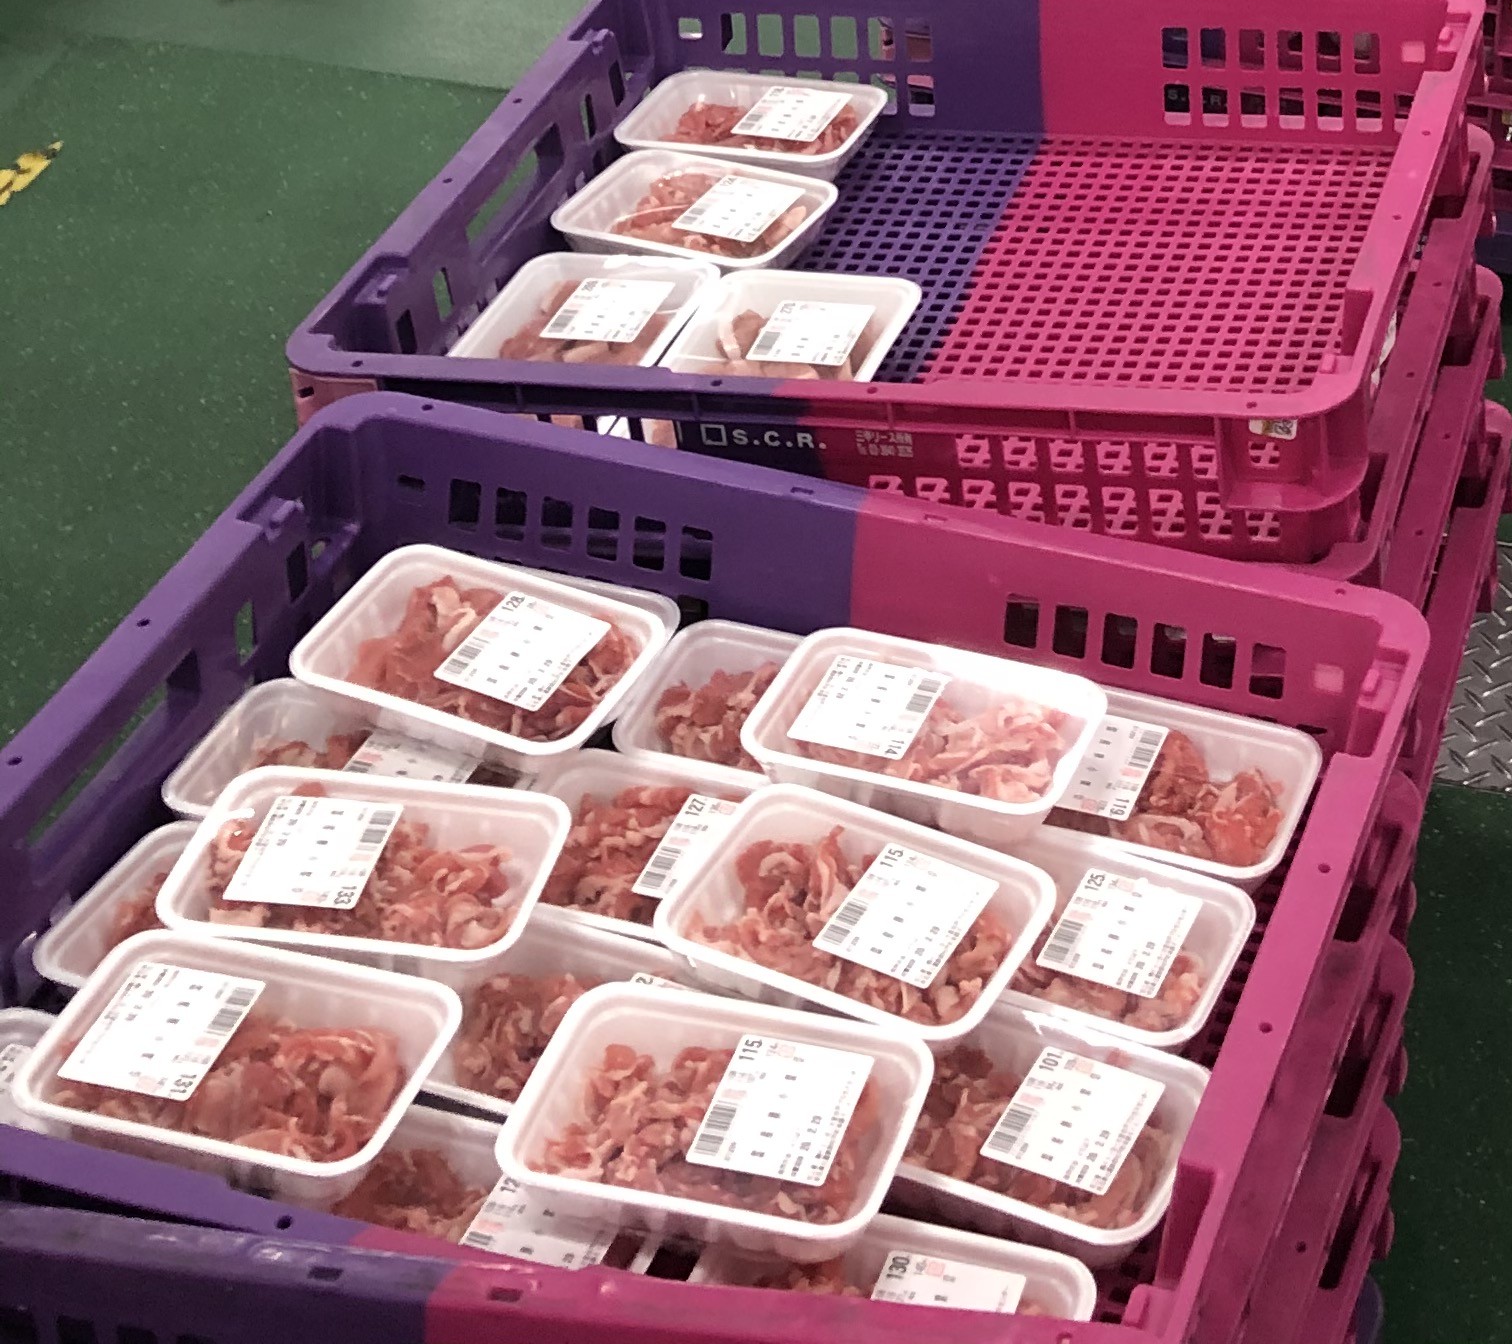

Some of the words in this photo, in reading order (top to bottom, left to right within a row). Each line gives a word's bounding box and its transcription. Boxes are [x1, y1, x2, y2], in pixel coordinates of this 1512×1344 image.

[732, 428, 827, 450] S.C.R.
[884, 739, 905, 755] 114
[684, 797, 706, 816] 127
[1109, 798, 1130, 816] 119
[333, 885, 357, 905] 133
[738, 1039, 763, 1061] 115
[169, 1073, 197, 1094] 131
[886, 1256, 910, 1280] 130
